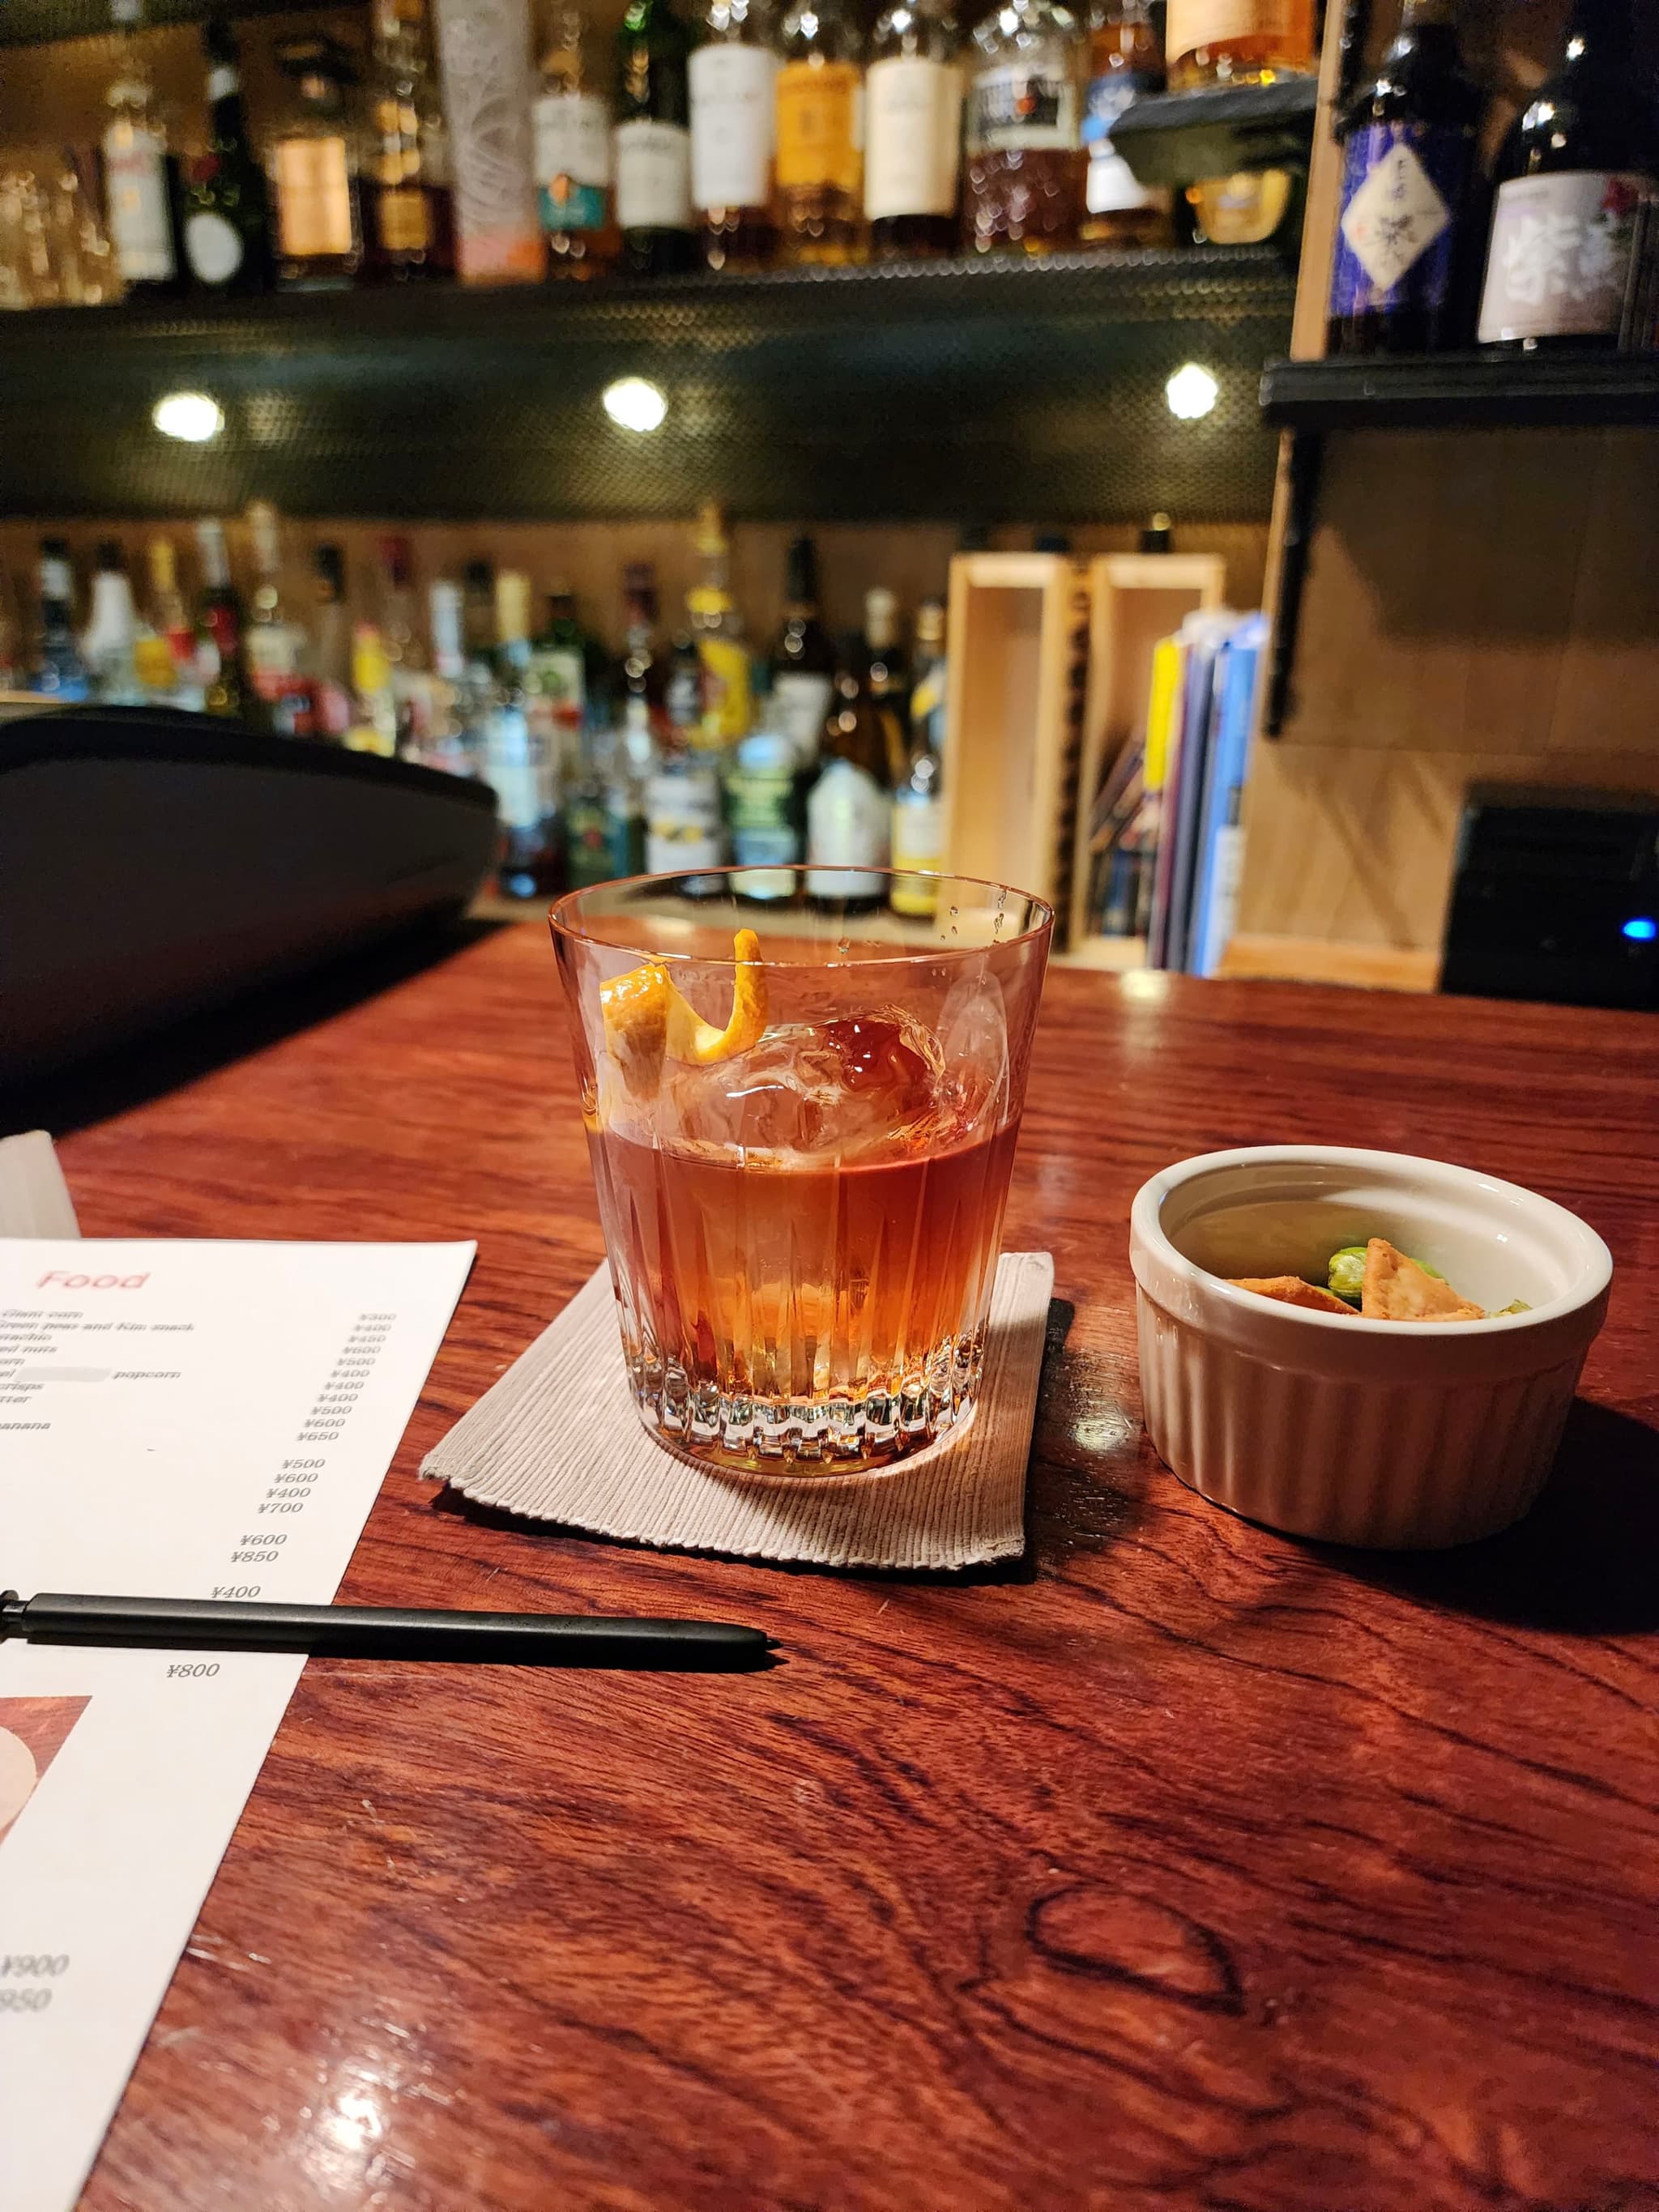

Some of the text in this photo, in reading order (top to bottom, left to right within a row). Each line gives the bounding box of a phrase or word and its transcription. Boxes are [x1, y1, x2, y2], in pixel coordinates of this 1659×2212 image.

[36, 1270, 151, 1290] Food
[82, 1322, 113, 1331] and
[22, 1345, 58, 1354] nuts
[112, 1371, 182, 1380] popcorn
[331, 1370, 370, 1379] ¥400
[324, 1381, 365, 1391] ¥400
[317, 1393, 359, 1403] ¥400
[310, 1405, 353, 1416] ¥500
[304, 1418, 347, 1428] ¥600
[296, 1431, 339, 1441] ¥650
[281, 1458, 326, 1469] ¥500
[274, 1473, 319, 1484] ¥600
[265, 1487, 312, 1499] ¥400
[257, 1502, 305, 1514] ¥700
[239, 1533, 288, 1546] ¥600
[230, 1550, 279, 1563] ¥850
[211, 1585, 262, 1599] ¥400
[166, 1664, 220, 1678] ¥800
